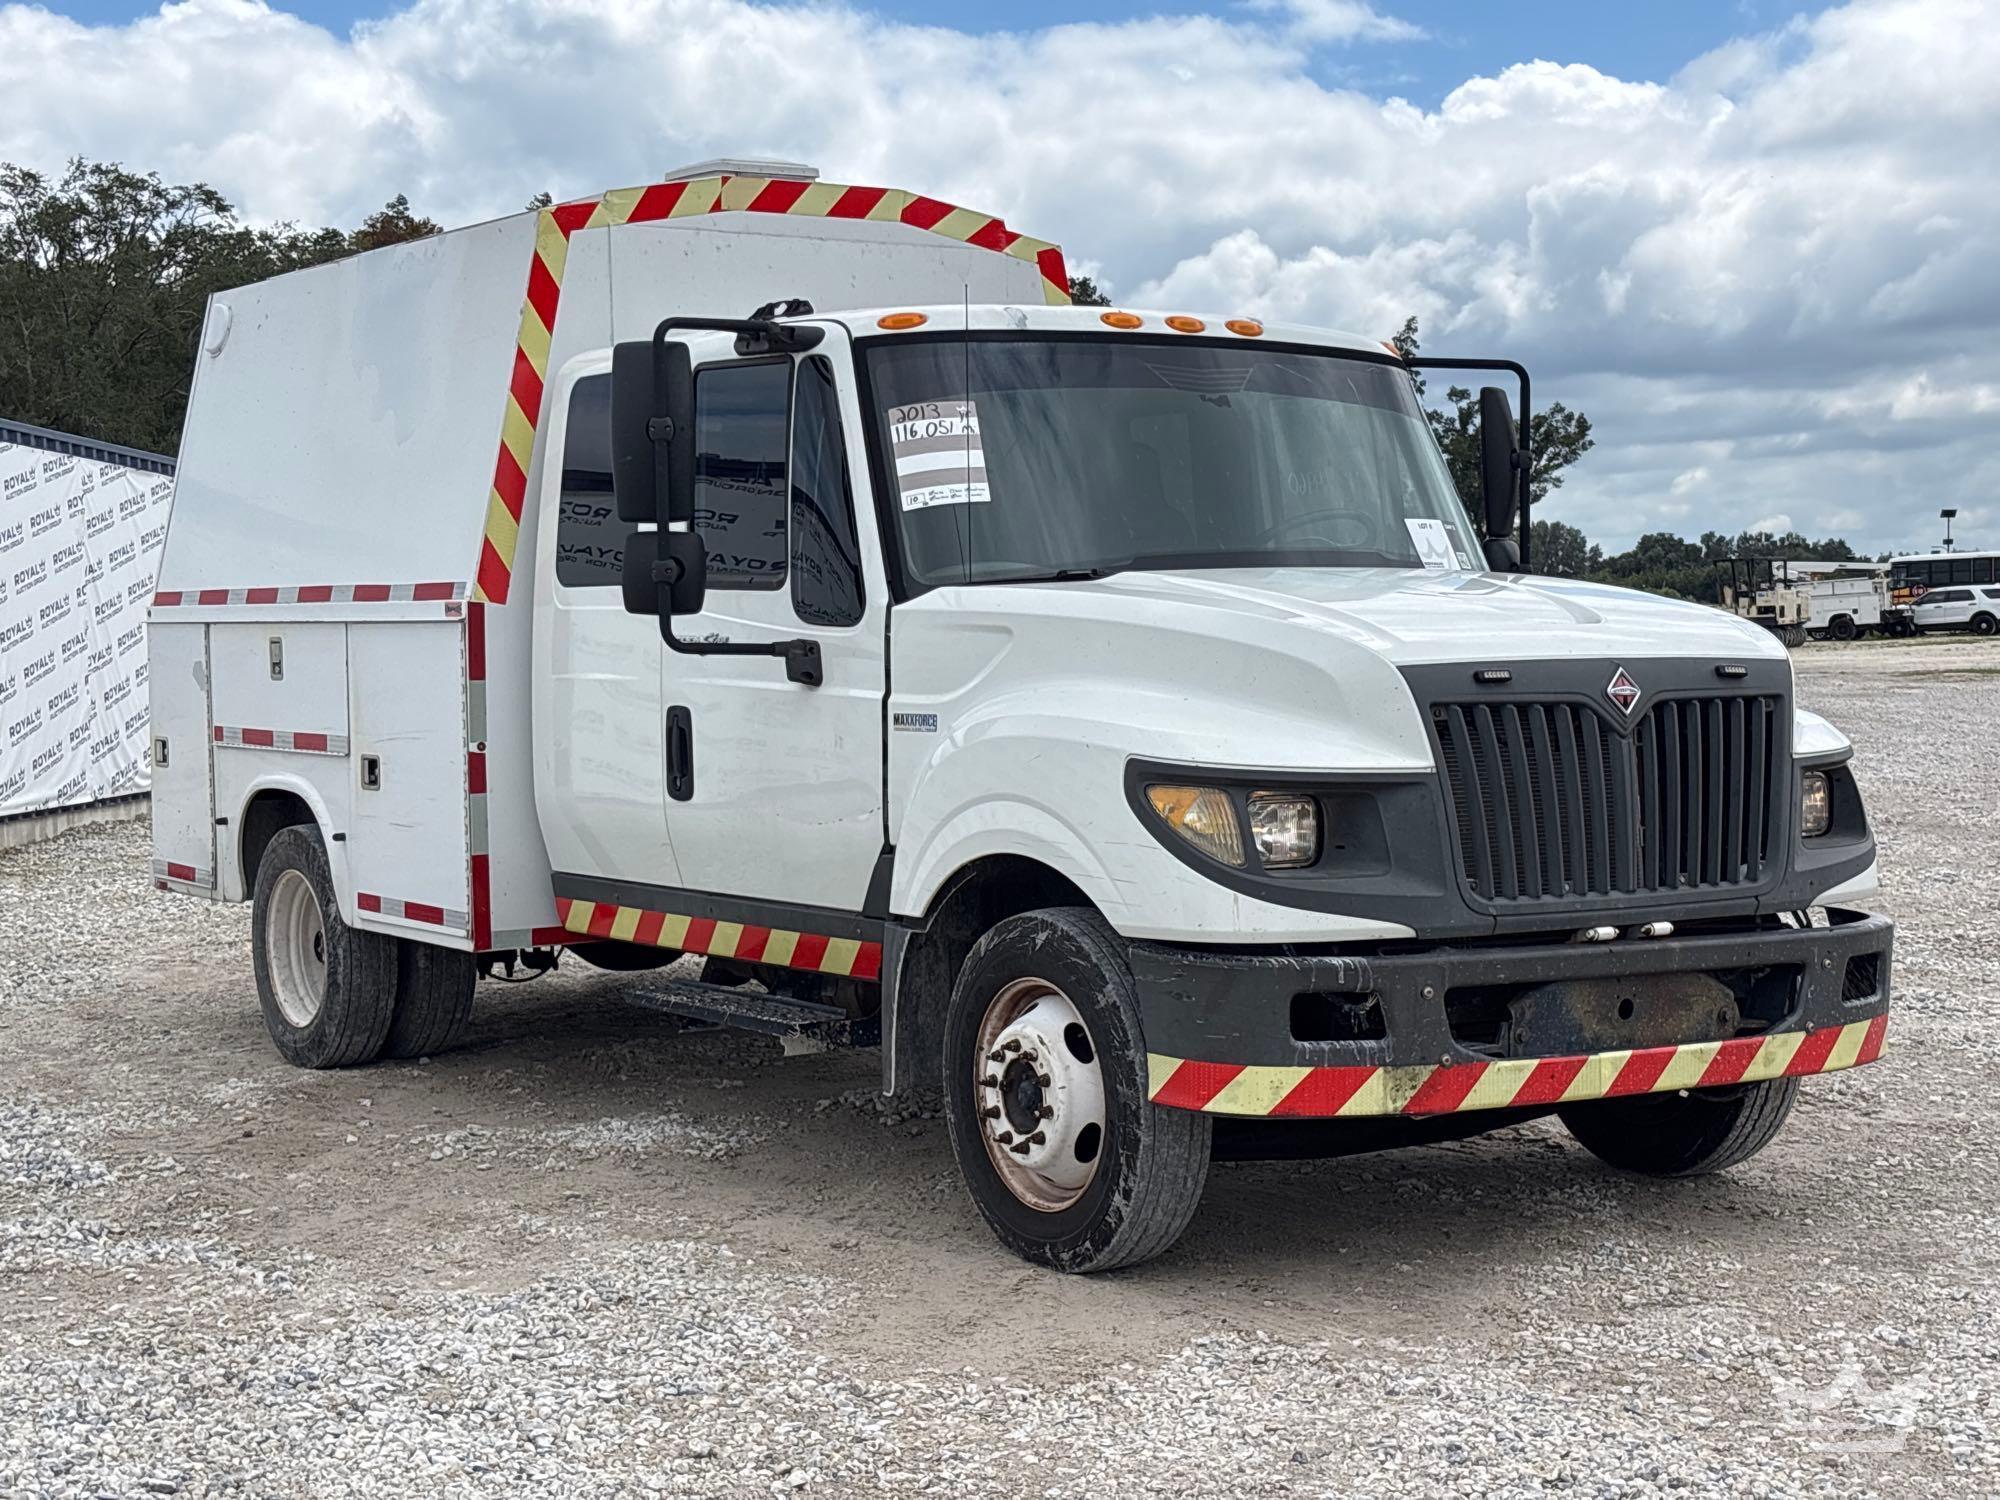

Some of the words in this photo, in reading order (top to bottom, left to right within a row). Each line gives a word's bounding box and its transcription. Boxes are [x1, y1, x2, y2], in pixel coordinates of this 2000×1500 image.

[896, 403, 940, 423] 2013
[896, 420, 954, 442] 116,051
[42, 456, 68, 474] ROYAL
[4, 471, 30, 492] ROYAL
[119, 495, 141, 513] ROYAL
[30, 509, 55, 529] ROYAL
[86, 512, 109, 530] ROYAL
[140, 528, 161, 546] ROYAL
[52, 545, 78, 565] ROYAL
[109, 545, 130, 564] ROYAL
[14, 564, 40, 586] ROYAL
[127, 578, 149, 597] ROYAL
[39, 600, 65, 621] ROYAL
[94, 596, 118, 617] ROYAL
[0, 621, 27, 644] ROYAL
[117, 628, 138, 648] ROYAL
[61, 633, 86, 655] ROYAL
[23, 656, 49, 680] ROYAL
[48, 688, 72, 711] ROYAL
[104, 682, 126, 703] ROYAL
[9, 714, 36, 738] ROYAL
[125, 711, 145, 732] ROYAL
[893, 713, 937, 727] MAXXFORCE
[32, 746, 57, 771] ROYAL
